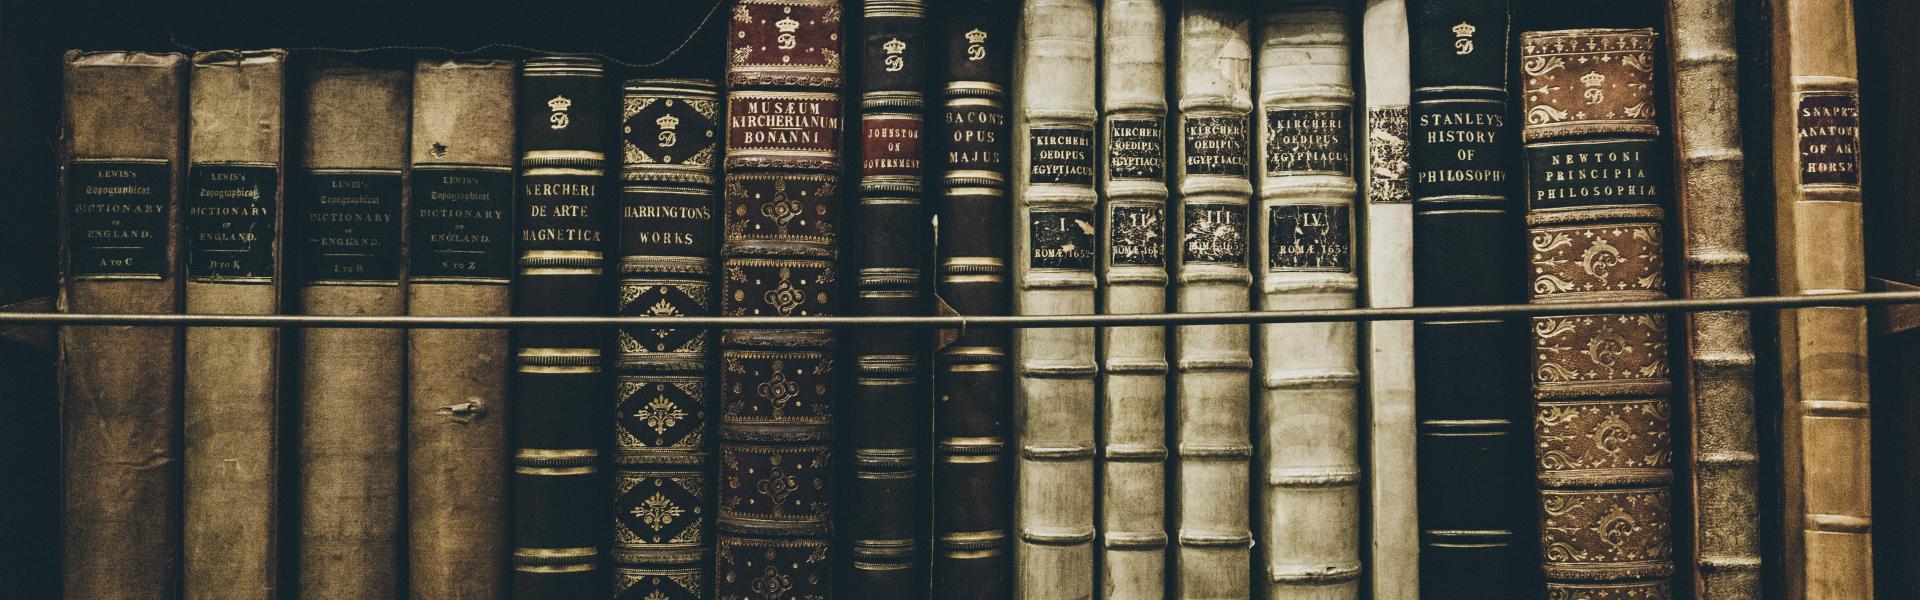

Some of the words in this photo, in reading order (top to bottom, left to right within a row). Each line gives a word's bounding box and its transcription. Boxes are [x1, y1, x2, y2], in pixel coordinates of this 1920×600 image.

[748, 102, 820, 115] MUSÆUM
[731, 114, 838, 129] KIRCHERIANUM
[1277, 119, 1342, 129] KIRCHERI
[1420, 113, 1503, 127] STANLEY'S
[744, 130, 819, 144] BONANNI
[867, 128, 919, 139] JOHNSTON
[954, 130, 995, 143] OPUS
[1114, 127, 1160, 138] KIRCHERI
[1428, 130, 1496, 143] HISTORY
[1037, 135, 1089, 147] KIRCHERI
[1119, 140, 1160, 151] OEDIPUS
[1194, 140, 1240, 149] OEDIPUS
[1282, 135, 1339, 145] OEDIPUS
[888, 142, 901, 152] ON
[1809, 144, 1828, 154] OF
[1836, 144, 1852, 154] AN
[950, 151, 1000, 163] MAJUS
[1040, 150, 1085, 160] OEDIPUS
[1457, 149, 1475, 161] OF
[1551, 151, 1640, 165] NEWTONI
[863, 158, 920, 169] GOVERNMENT
[1807, 162, 1853, 173] HORSE
[1032, 164, 1093, 176] ÆGYPTIACUS
[1545, 168, 1645, 181] PRINCIPIA
[526, 183, 595, 196] KERCHERI
[75, 204, 163, 213] DICTIONARY
[190, 207, 268, 216] DICTIONARY
[420, 209, 503, 219] DICTIONARY
[531, 205, 547, 217] DE
[553, 205, 588, 217] ARTE
[310, 213, 392, 223] DICTIONARY
[1130, 213, 1147, 227] II
[1207, 210, 1231, 224] III
[640, 232, 694, 245] WORKS
[1035, 248, 1063, 258] ROMÆ
[1279, 245, 1315, 254] ROMÆ
[125, 258, 133, 266] C
[233, 261, 240, 270] K
[467, 262, 476, 270] Z
